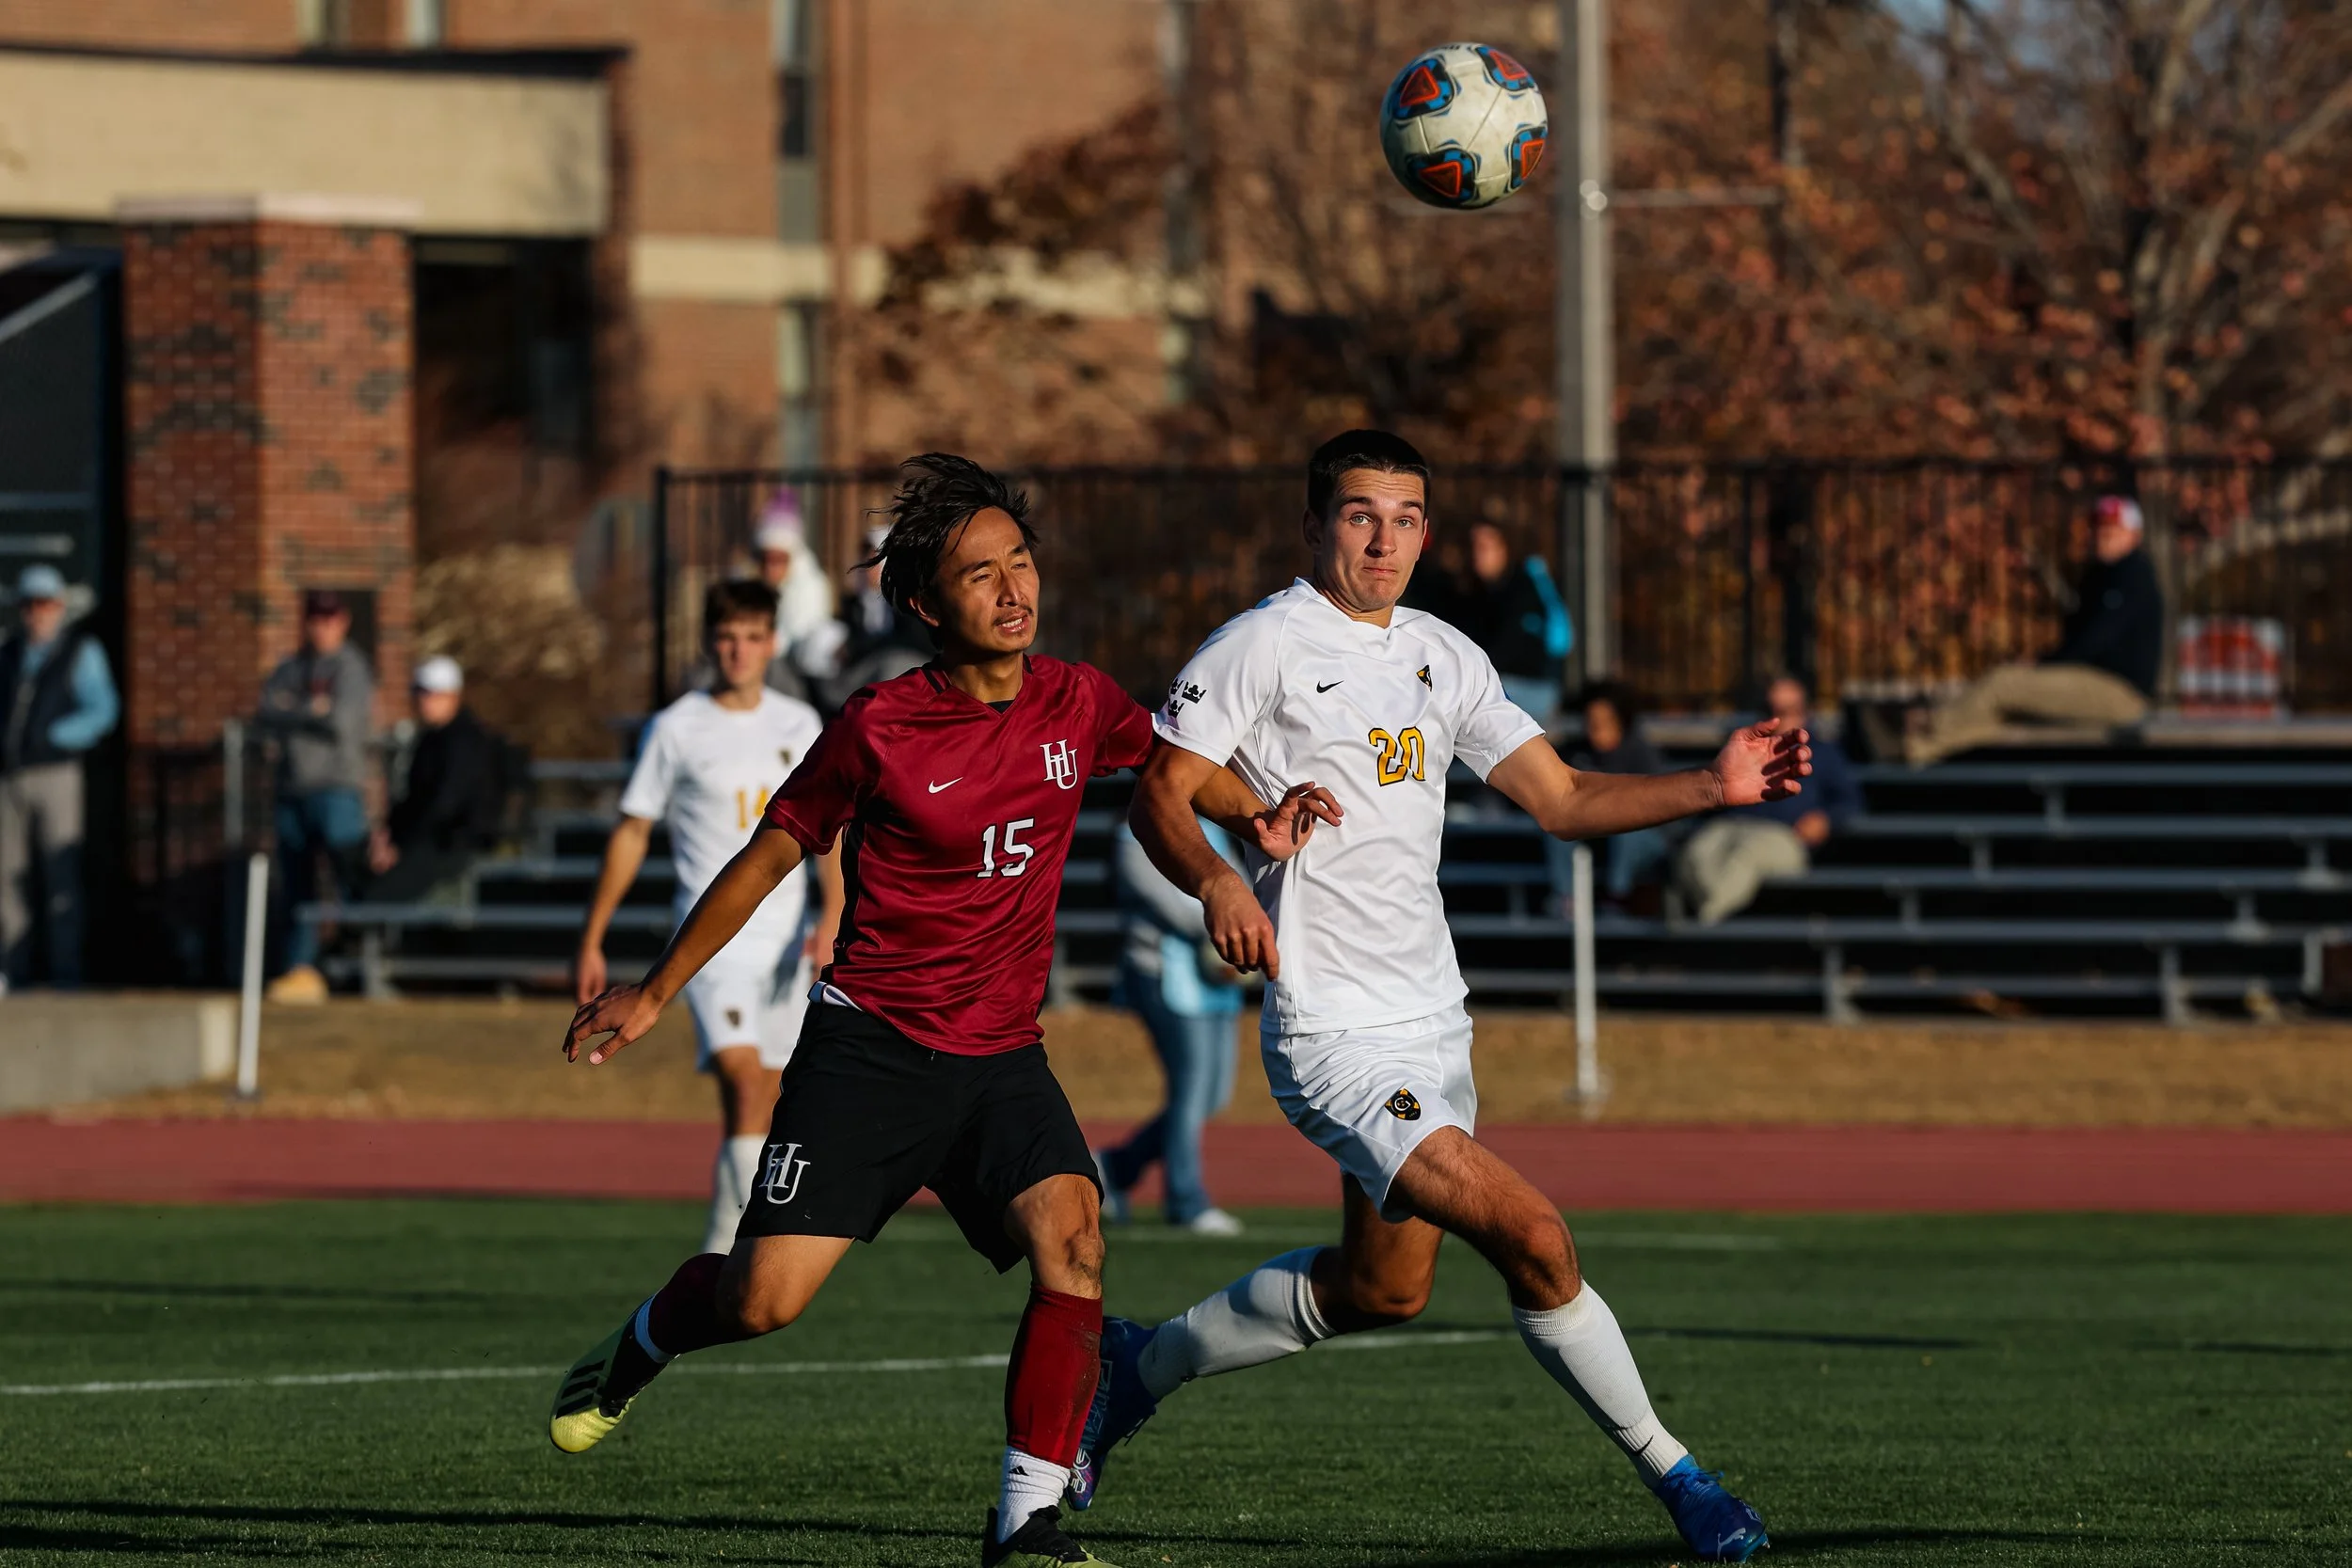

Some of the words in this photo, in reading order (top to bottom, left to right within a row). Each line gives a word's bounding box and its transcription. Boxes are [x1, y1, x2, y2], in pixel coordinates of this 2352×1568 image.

[1040, 738, 1078, 790] HU
[1368, 726, 1426, 786] 20
[977, 817, 1035, 878] 15
[758, 1142, 811, 1204] HU
